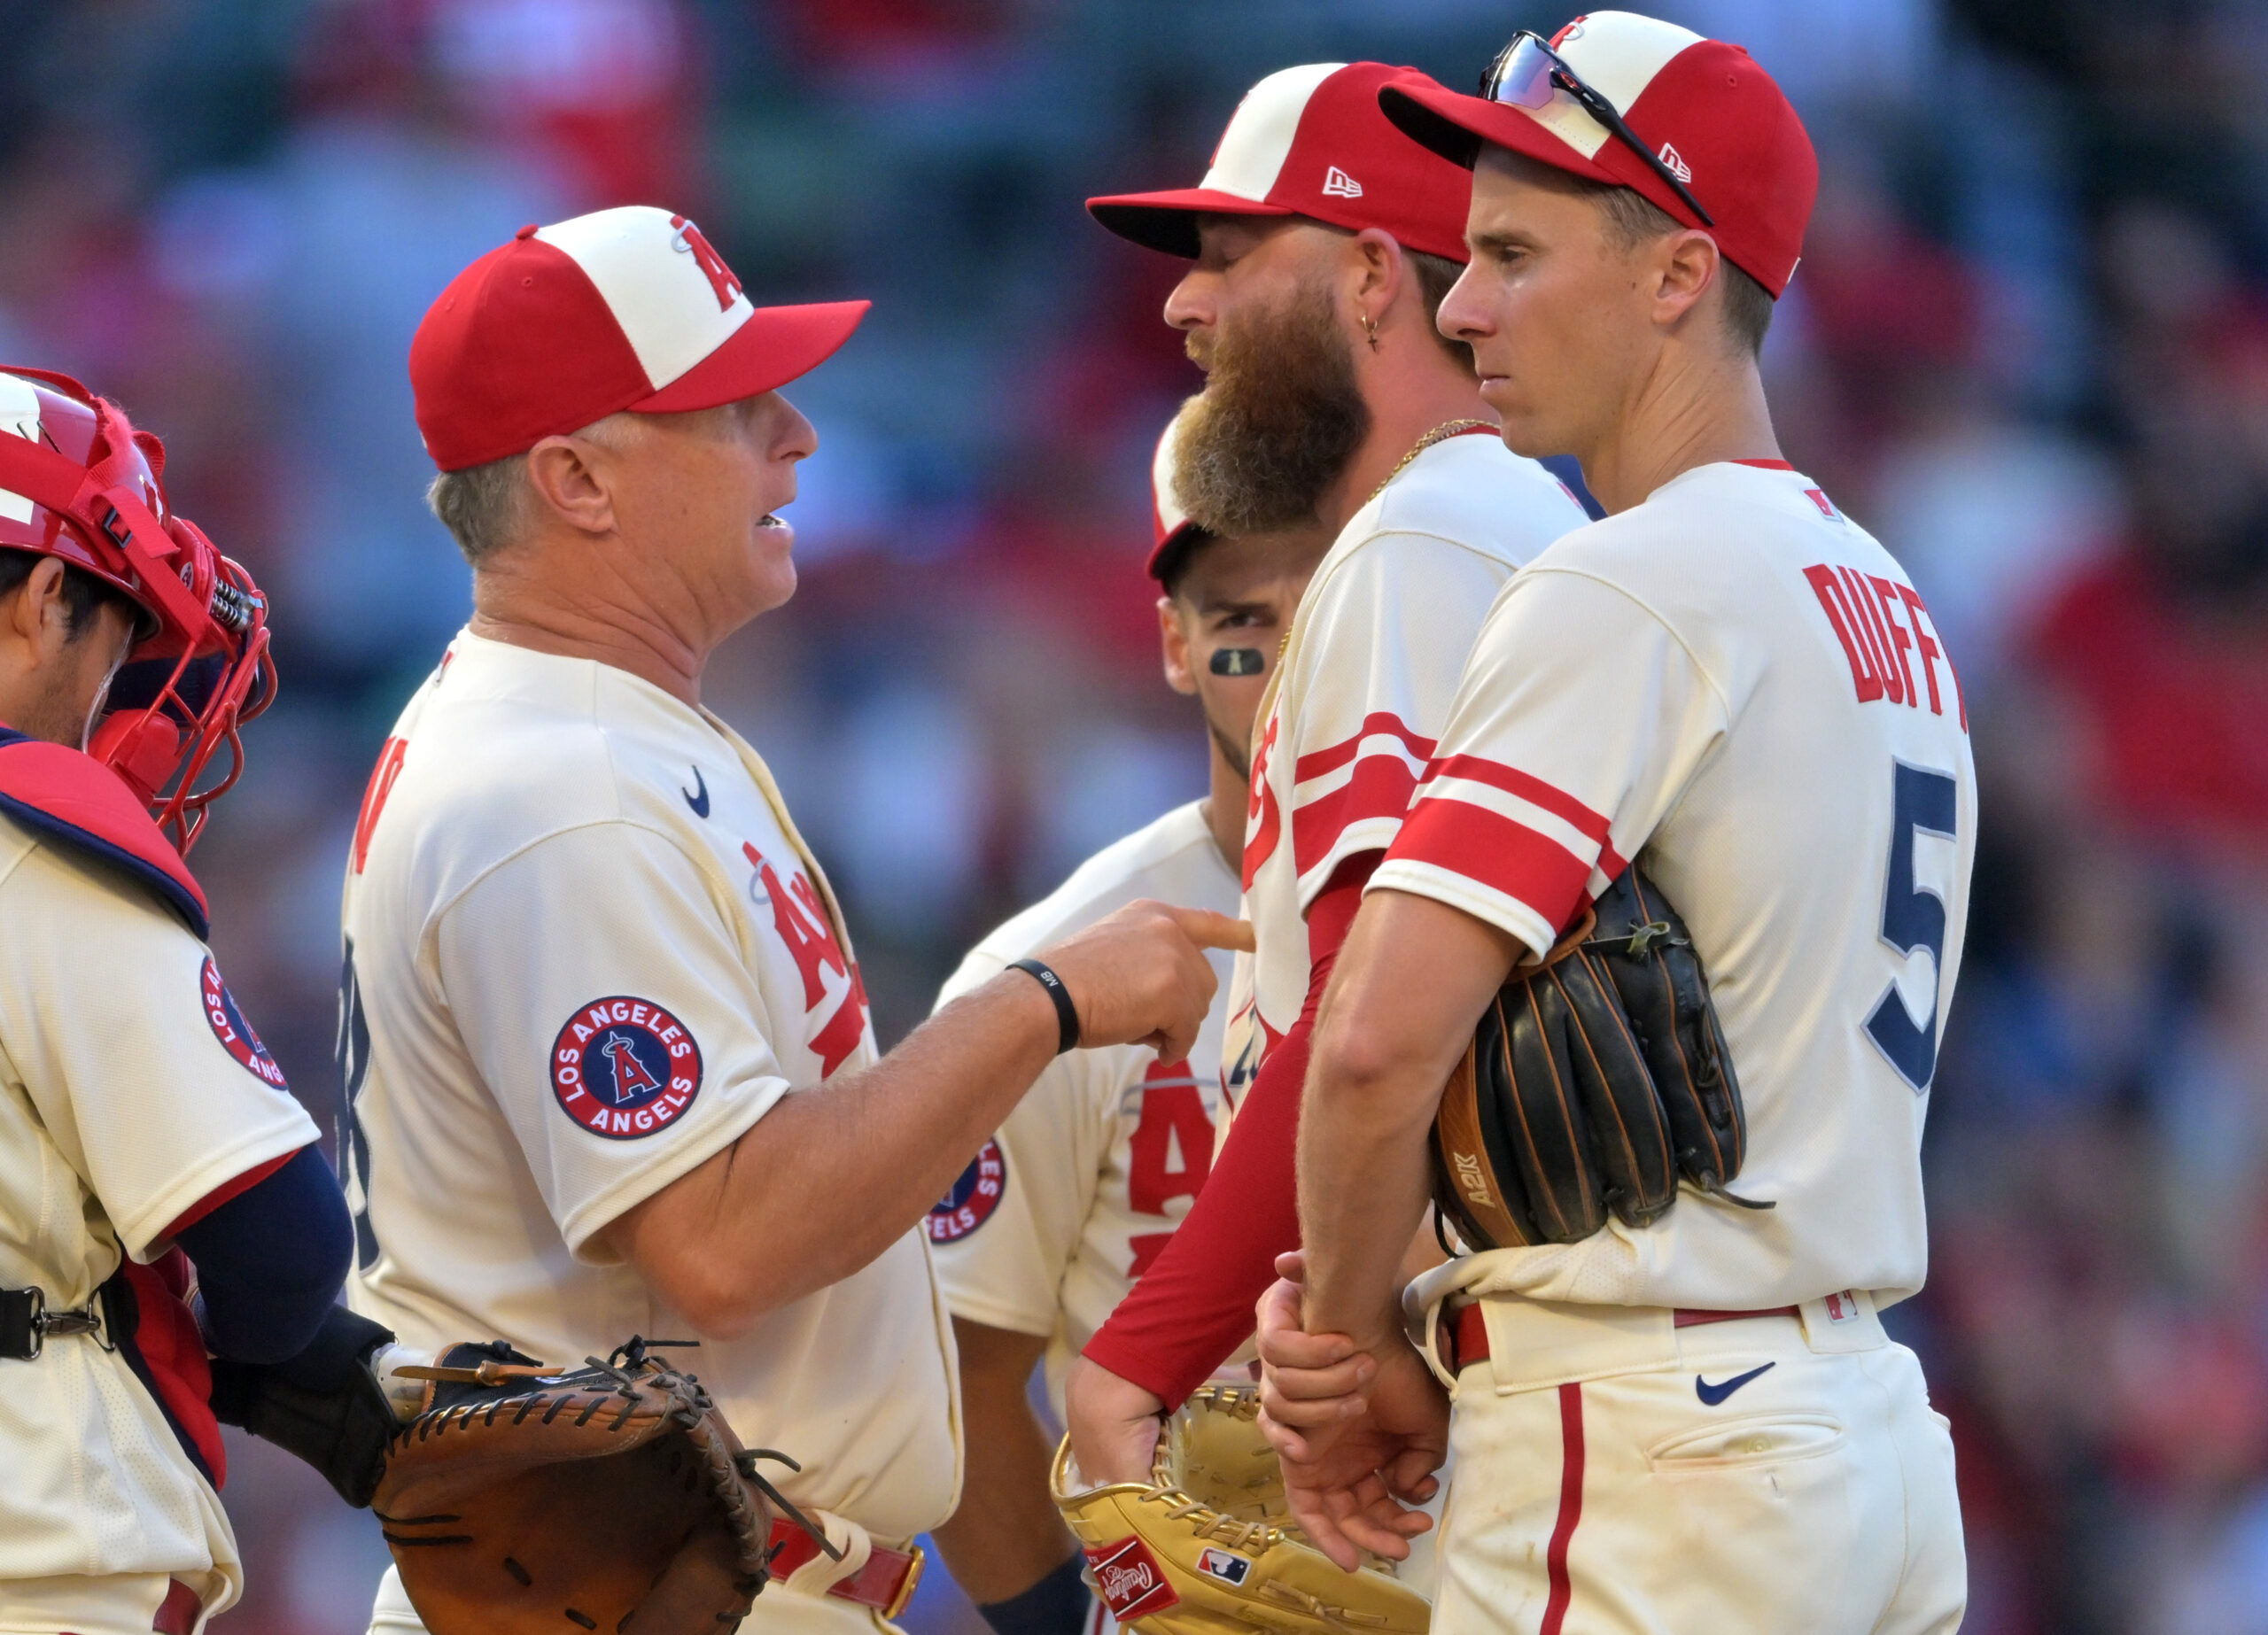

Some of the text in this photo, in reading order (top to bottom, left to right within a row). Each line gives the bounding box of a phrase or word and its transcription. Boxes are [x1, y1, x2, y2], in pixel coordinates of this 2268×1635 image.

[1802, 563, 1968, 735] DUFF
[1860, 755, 1957, 1096] 5
[206, 992, 237, 1043] LOS
[558, 1002, 691, 1103] LOS ANGELES
[590, 1076, 693, 1133] ANGELS
[1453, 1151, 1496, 1208] A2K
